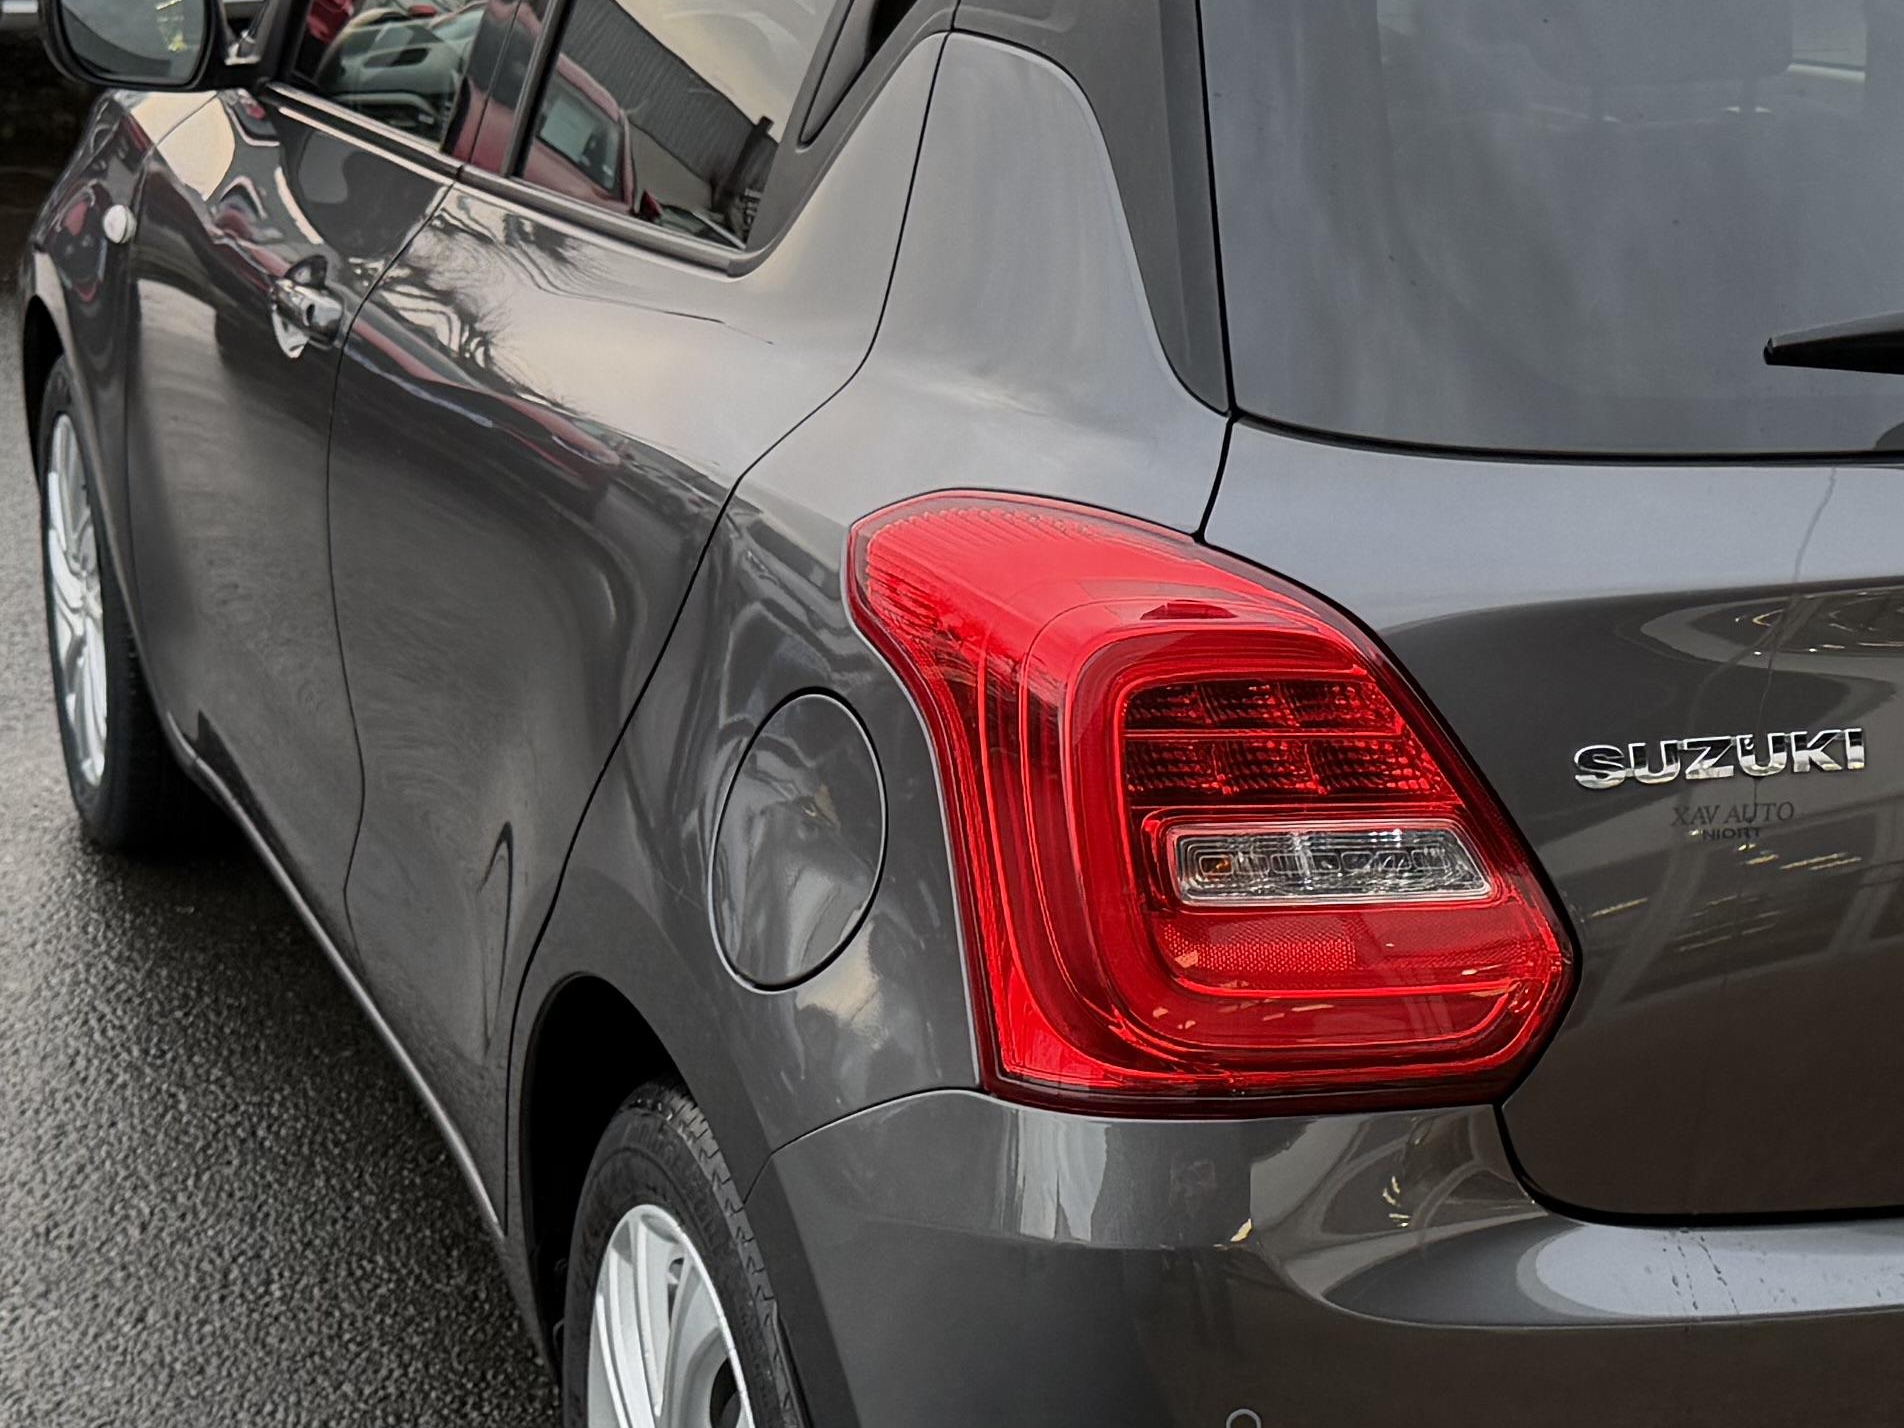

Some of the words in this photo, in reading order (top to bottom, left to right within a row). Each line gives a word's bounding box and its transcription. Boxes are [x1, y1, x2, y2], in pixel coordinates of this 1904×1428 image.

[1573, 727, 1866, 790] SUZUKI
[1670, 805, 1721, 827] XAV
[1723, 800, 1795, 824] AUTO
